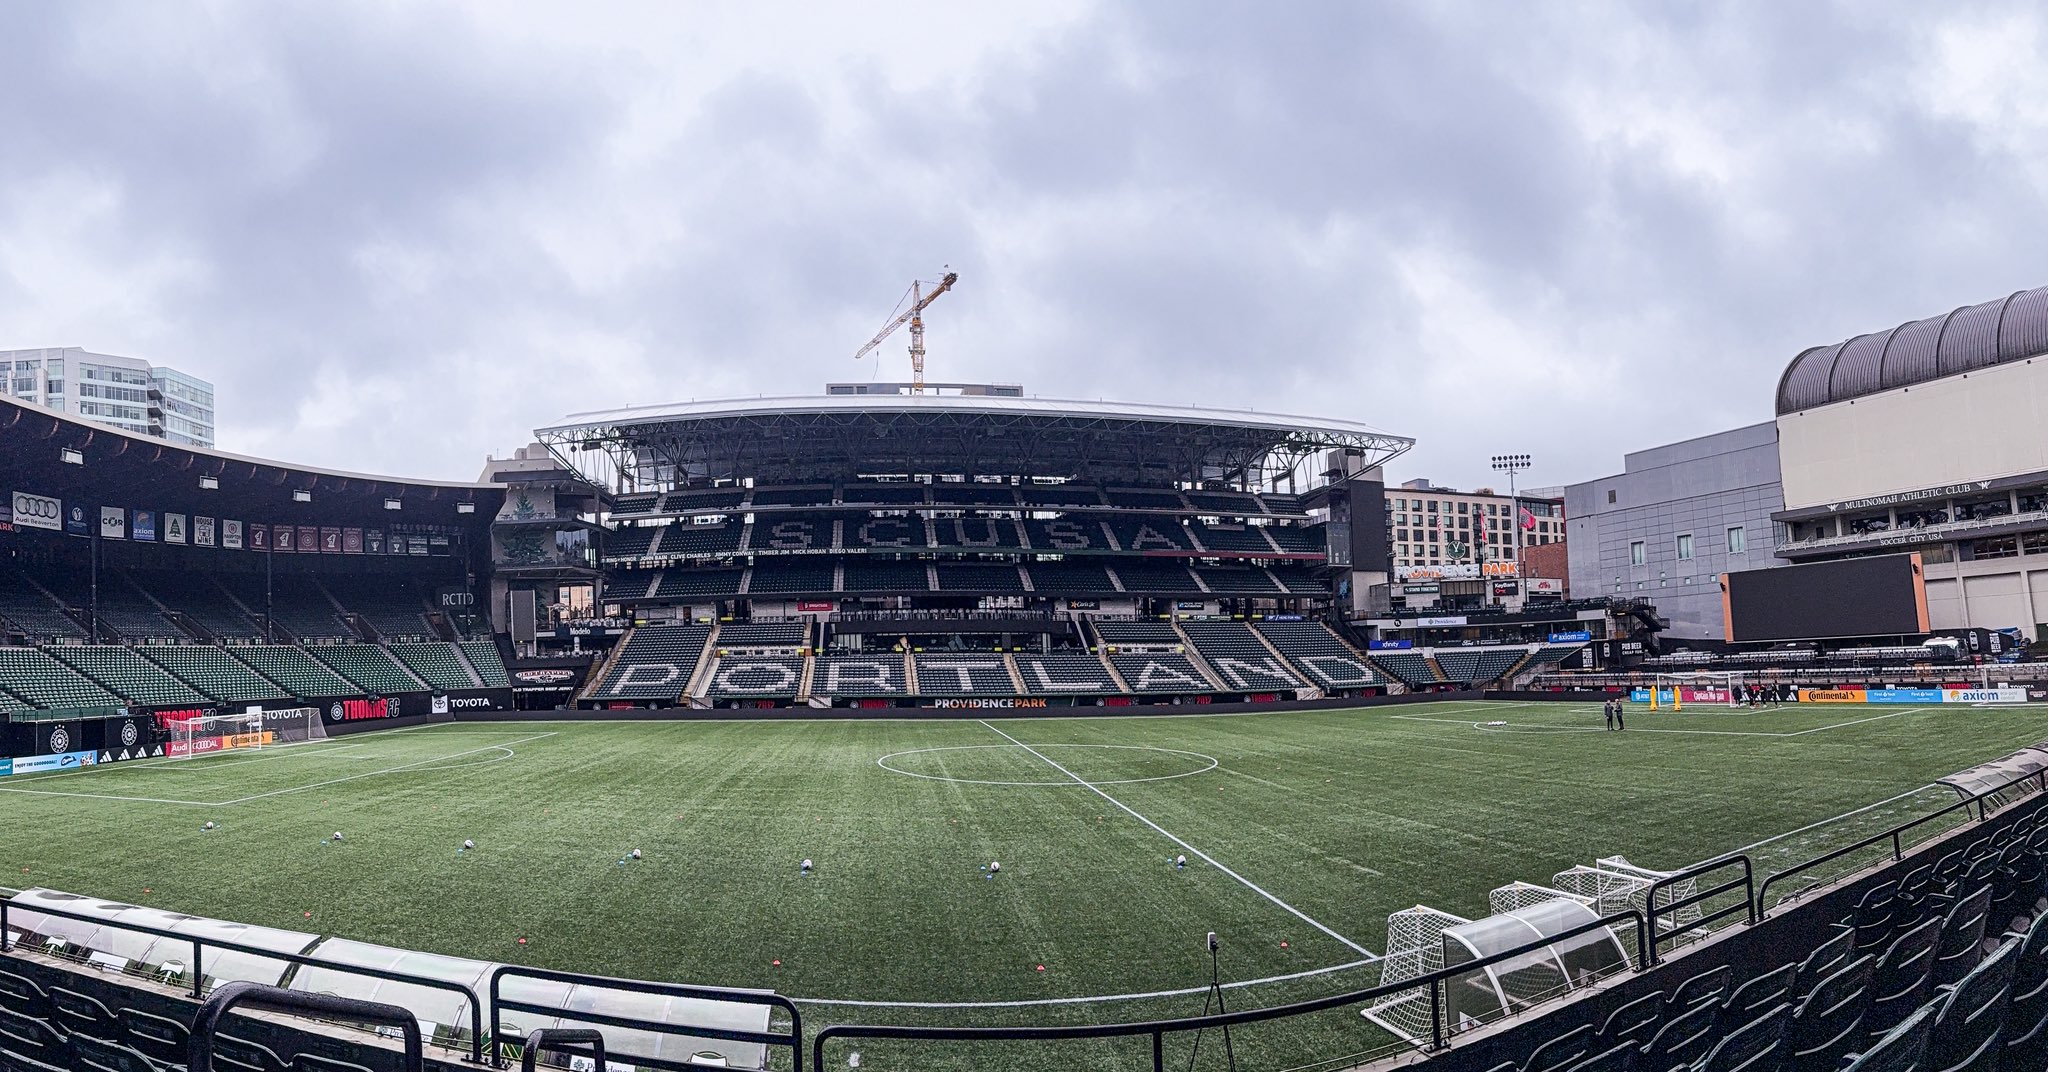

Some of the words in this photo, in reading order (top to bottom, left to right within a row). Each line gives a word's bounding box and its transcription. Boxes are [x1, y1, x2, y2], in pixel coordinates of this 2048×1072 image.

[1844, 495, 1898, 510] MULTNOMAH
[1901, 488, 1943, 502] ATHLETIC
[1946, 484, 1971, 495] CLUB
[15, 516, 30, 524] Audi
[30, 517, 60, 528] Beaverton
[195, 517, 214, 527] HOUSE
[133, 527, 154, 535] axiom
[197, 536, 212, 545] WINE
[1879, 537, 1907, 546] SOCCER
[1909, 535, 1926, 543] CITY
[1928, 532, 1944, 541] USA
[1394, 563, 1480, 579] PROVIDENCE
[1482, 561, 1519, 576] PARK
[442, 592, 474, 606] RCTID
[569, 627, 591, 635] Modelo
[1558, 632, 1577, 641] axiom
[1621, 642, 1631, 650] PUB
[1631, 642, 1642, 650] BEER
[1808, 690, 1849, 702] Continental
[1963, 690, 1999, 701] axiom
[450, 698, 490, 708] TOYOTA
[934, 698, 1047, 709] PROVIDENCEPARK
[265, 709, 303, 720] TOYOTA
[171, 742, 188, 753] Audi
